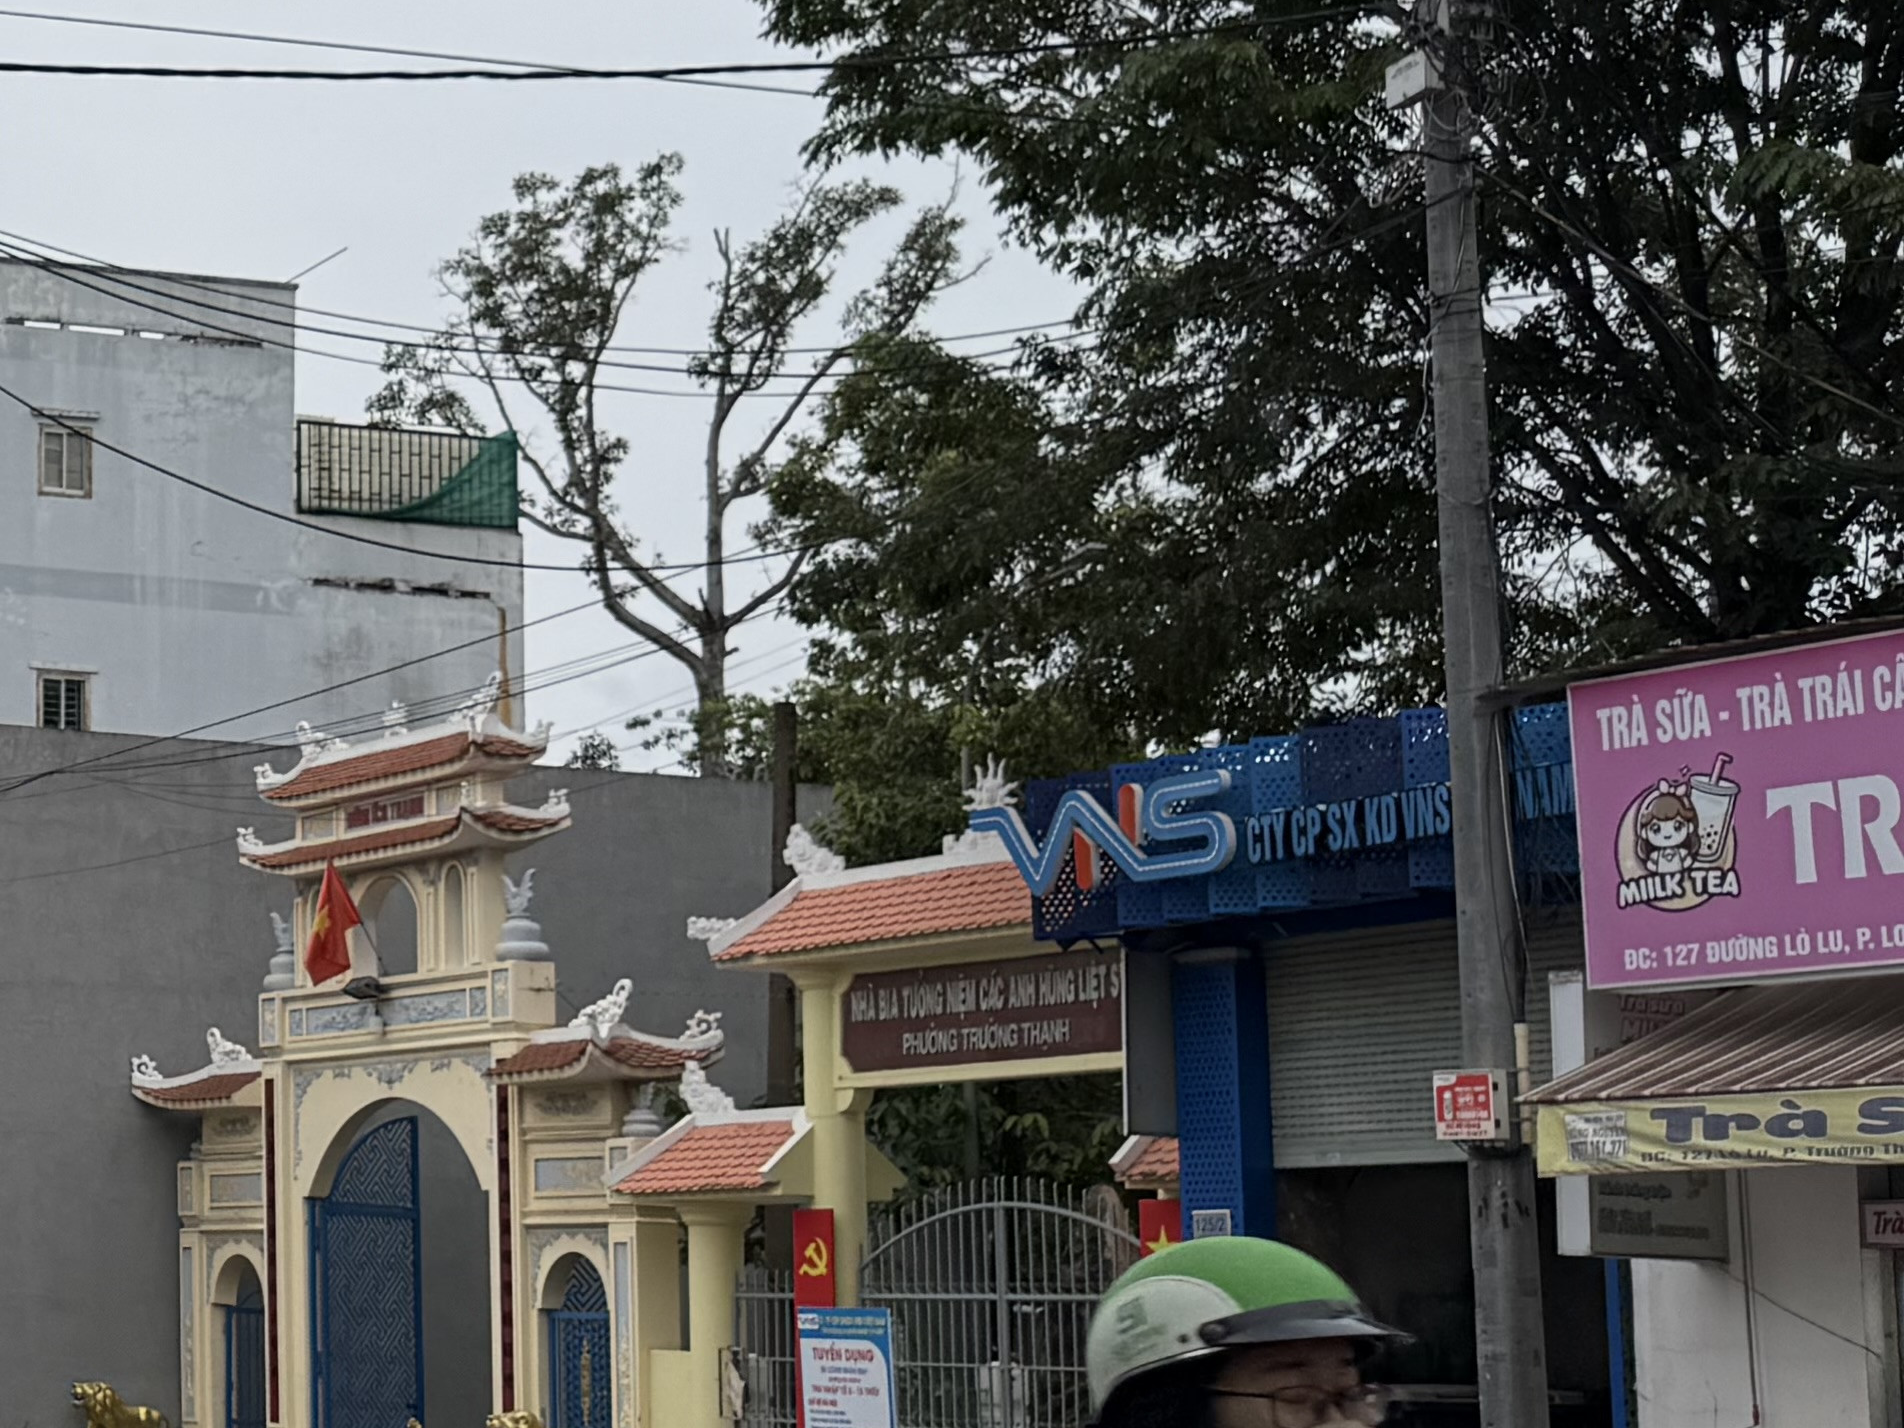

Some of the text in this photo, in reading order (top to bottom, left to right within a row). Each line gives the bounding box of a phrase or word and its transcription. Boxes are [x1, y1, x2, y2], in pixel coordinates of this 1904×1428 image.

[1596, 694, 1649, 752] TRÀ
[1655, 687, 1712, 744] SỮA
[1735, 672, 1793, 732] TRÀ
[1797, 661, 1865, 724] TRÁI
[1246, 765, 1576, 864] CTY CP SX KD VNS NAM
[1691, 869, 1741, 898] TEA
[1624, 949, 1658, 971] ĐC:
[1663, 943, 1700, 968] 127
[1706, 934, 1778, 965] ĐƯỜNG
[1784, 927, 1811, 957] LÒ
[1817, 928, 1851, 956] LU,
[1856, 927, 1875, 950] P.
[850, 983, 876, 1022] NHÀ
[878, 987, 900, 1020] BIA
[946, 973, 976, 1020] NIỆM
[979, 969, 1005, 1012] CÁC
[1008, 974, 1037, 1009] ANH
[1078, 959, 1108, 1009] LIỆT
[1109, 963, 1120, 999] S
[1021, 1017, 1072, 1051] THẠNH
[1649, 1099, 1829, 1144] Trà
